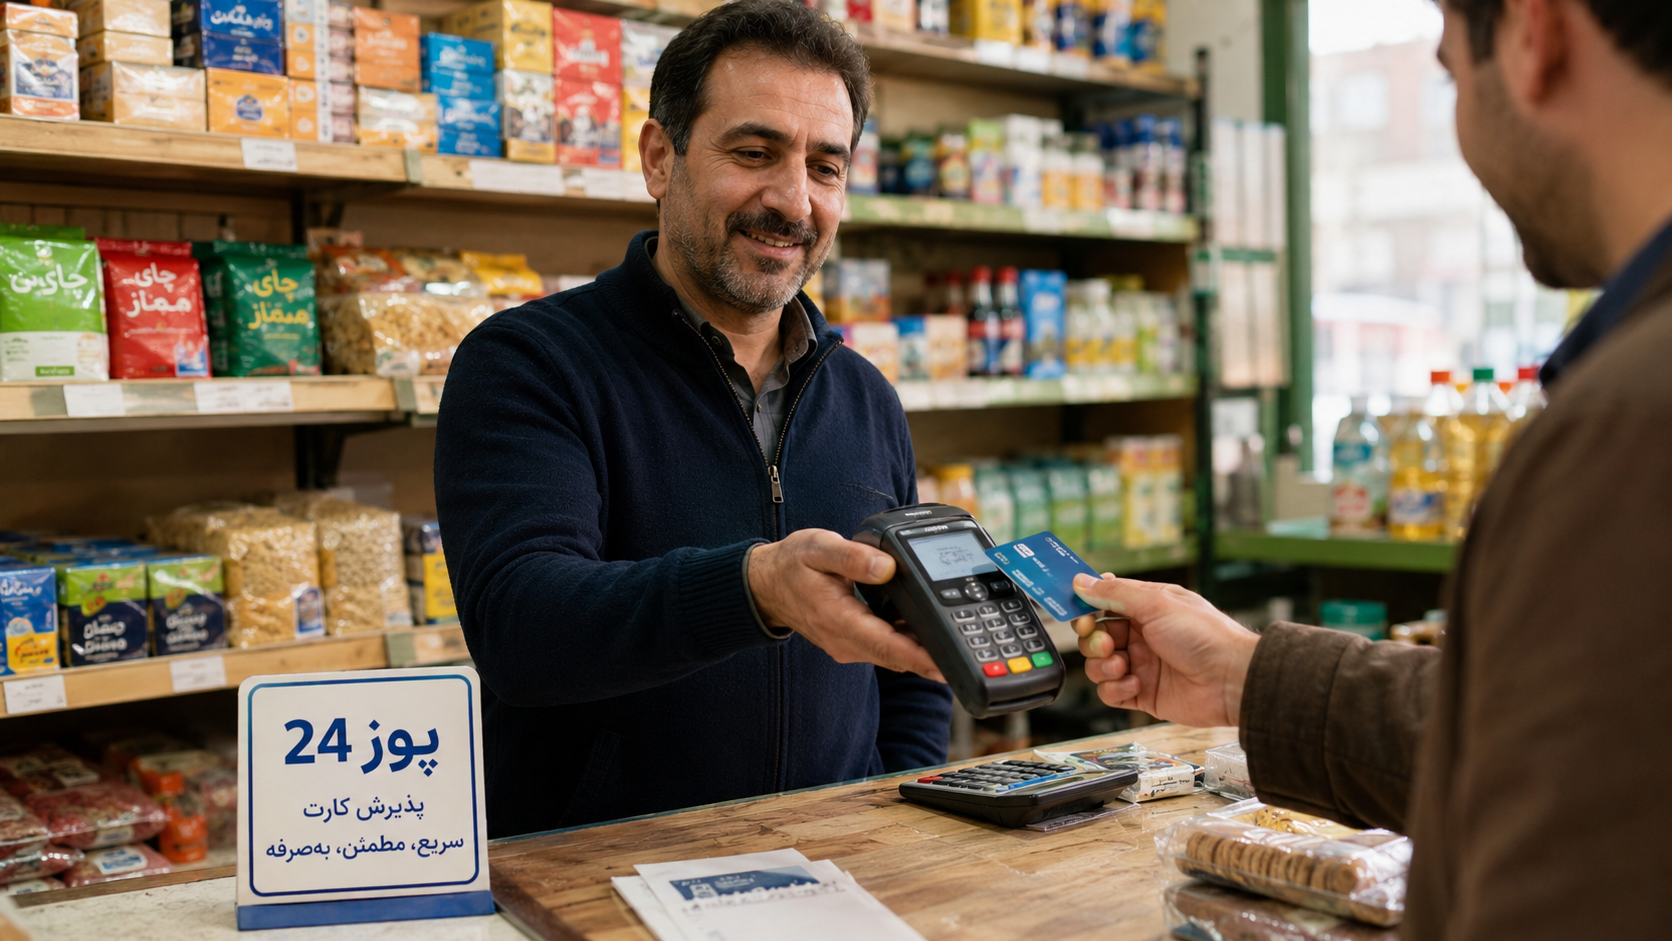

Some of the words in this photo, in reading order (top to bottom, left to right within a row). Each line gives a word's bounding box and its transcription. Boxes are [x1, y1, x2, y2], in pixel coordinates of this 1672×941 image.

[283, 717, 353, 766] 24
[360, 719, 440, 778] پوز
[303, 797, 351, 824] کارت
[356, 794, 425, 822] پذیرش
[410, 837, 464, 858] سریع،
